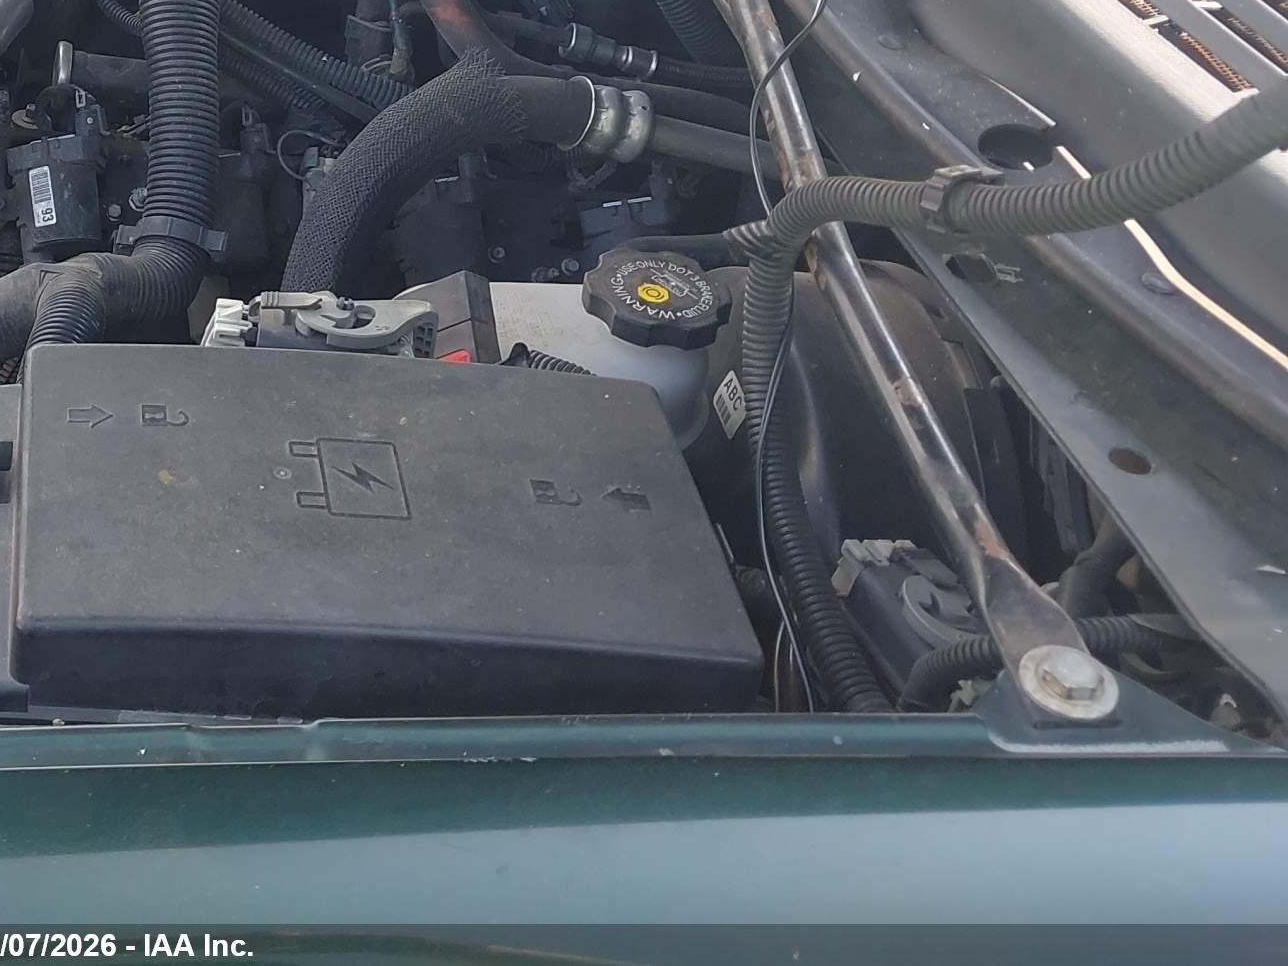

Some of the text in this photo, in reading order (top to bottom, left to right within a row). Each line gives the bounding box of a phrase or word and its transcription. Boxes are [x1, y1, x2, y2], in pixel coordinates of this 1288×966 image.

[41, 207, 54, 222] 93
[617, 262, 638, 276] USE
[635, 259, 666, 269] ONLY
[667, 262, 694, 277] DOT
[610, 277, 676, 320] WARNING
[723, 378, 743, 411] ABC
